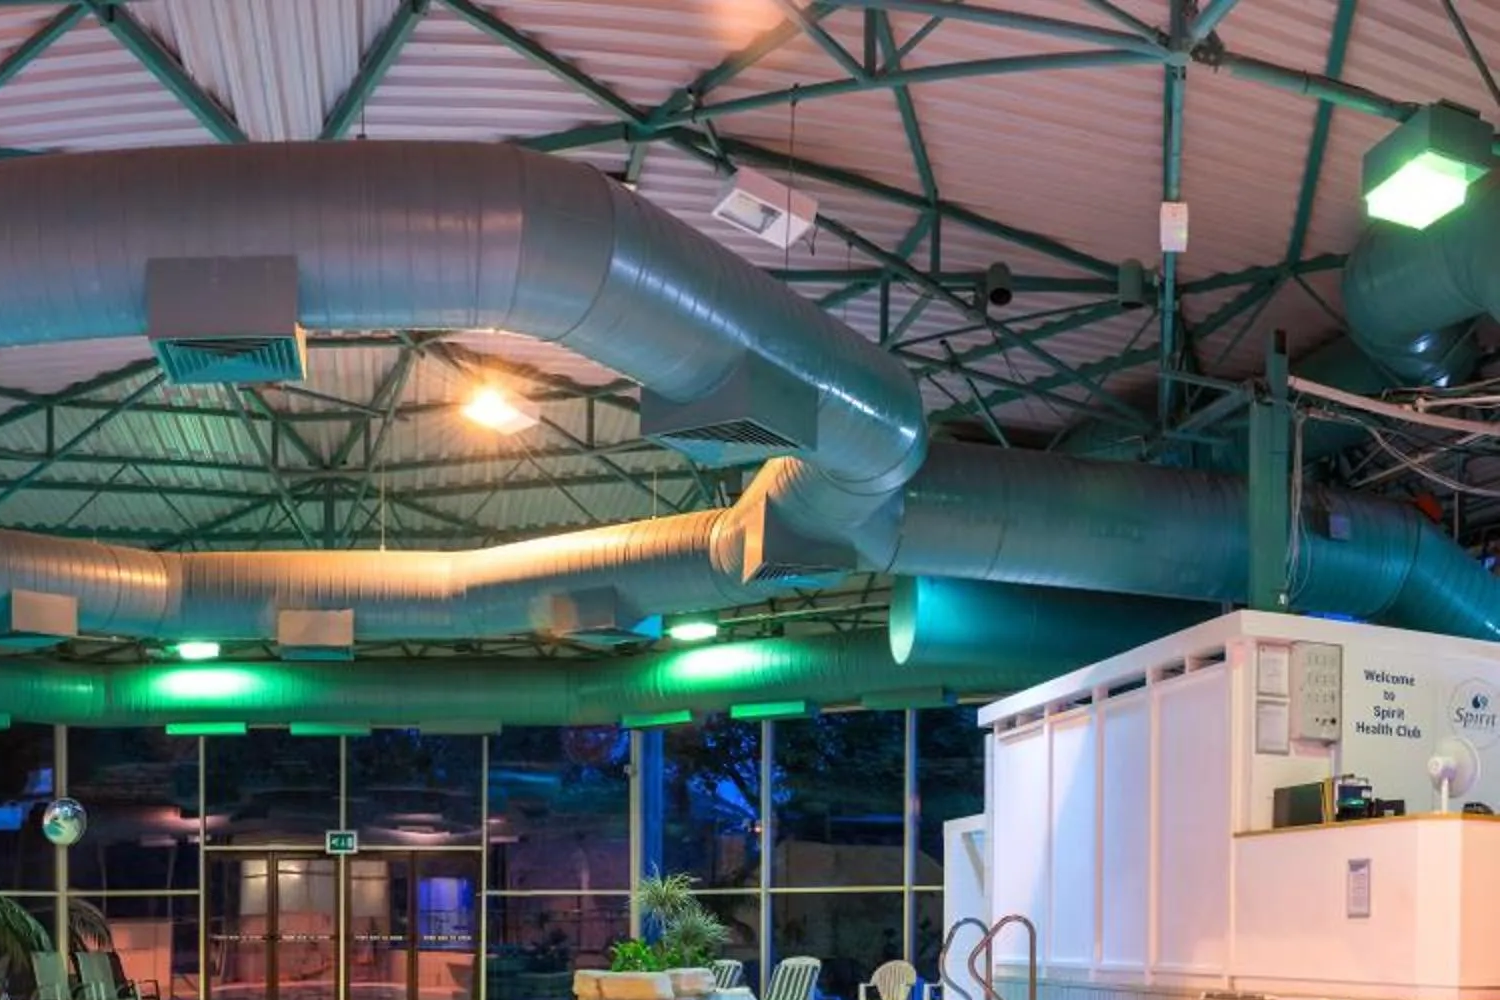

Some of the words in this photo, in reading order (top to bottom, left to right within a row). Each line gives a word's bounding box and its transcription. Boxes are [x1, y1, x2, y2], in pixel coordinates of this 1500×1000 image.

[1363, 669, 1416, 687] Welcome
[1383, 690, 1396, 701] to
[1373, 705, 1405, 721] Spirit
[1453, 707, 1496, 729] Spirit
[1355, 721, 1393, 737] Health
[1395, 724, 1422, 739] Club
